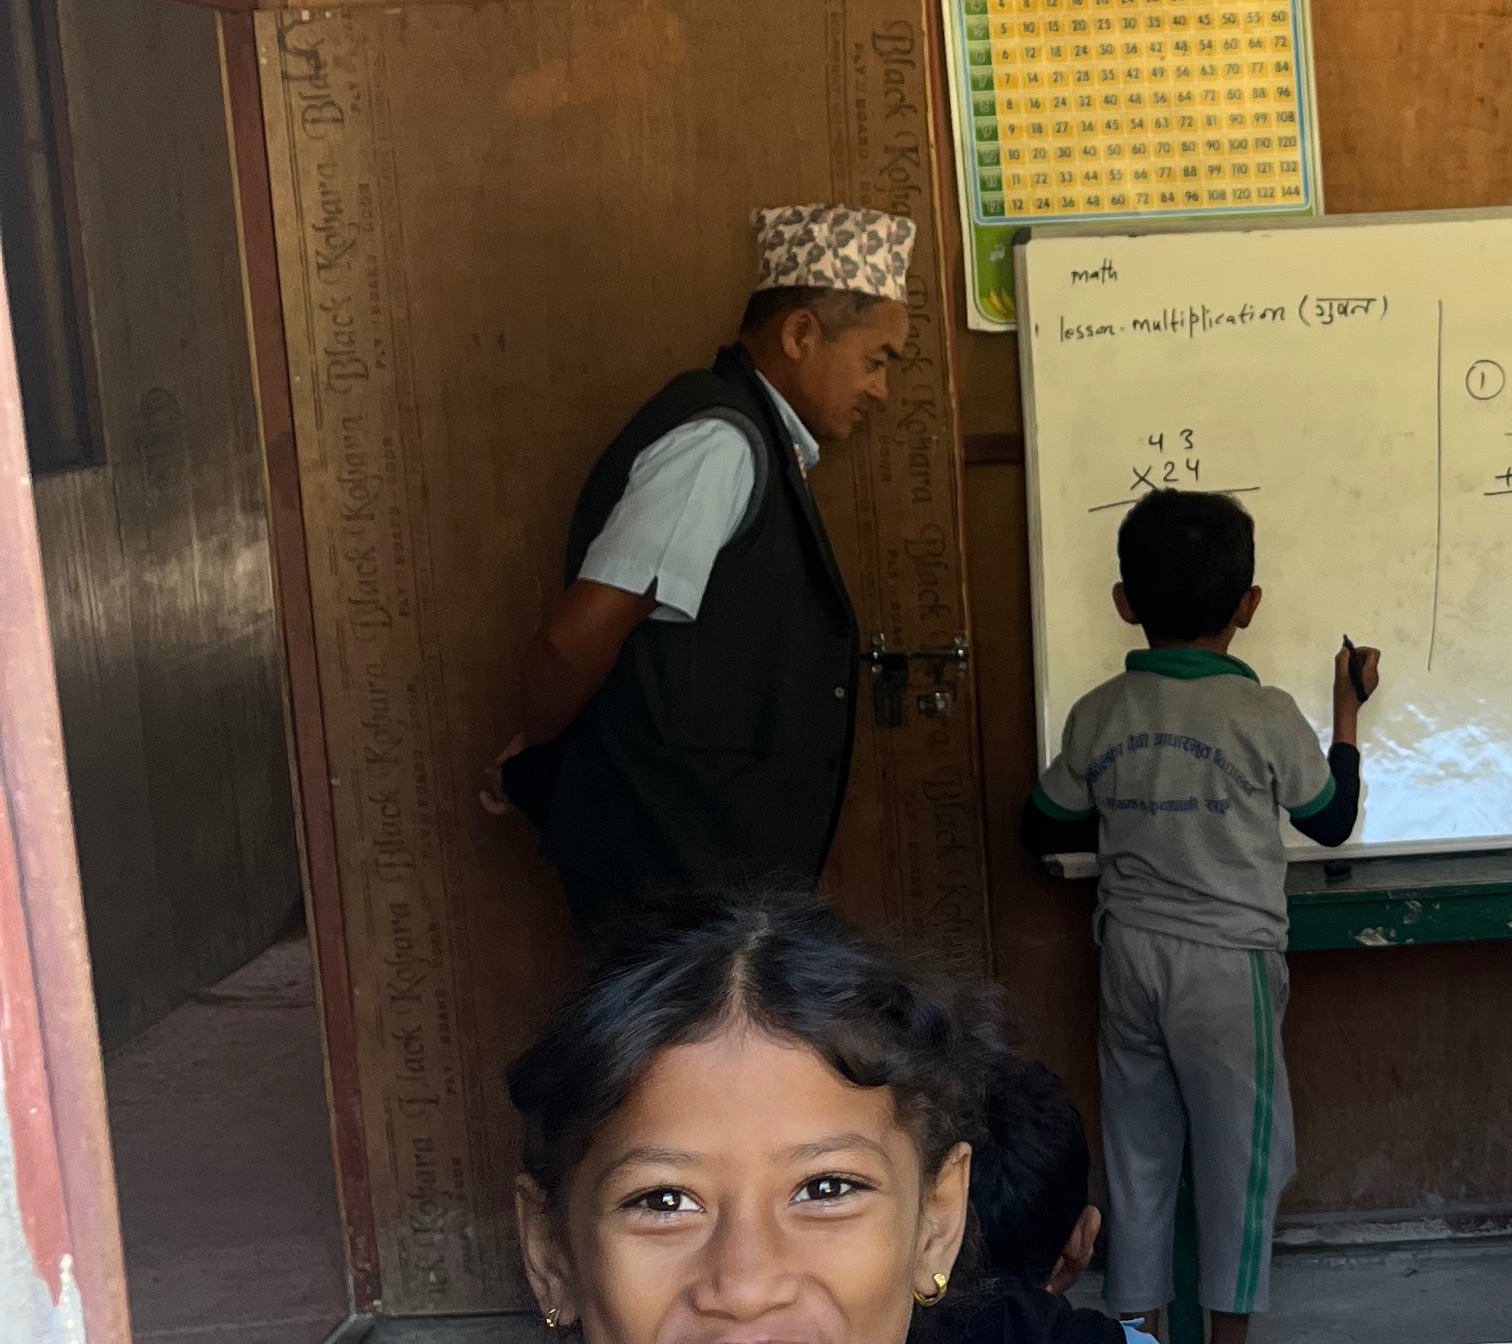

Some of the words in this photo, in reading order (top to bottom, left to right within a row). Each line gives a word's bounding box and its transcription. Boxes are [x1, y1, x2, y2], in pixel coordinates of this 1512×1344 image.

[1026, 72, 1039, 84] 14
[1051, 70, 1066, 84] 21
[1125, 67, 1140, 80] 42
[1150, 66, 1166, 79] 49
[1175, 65, 1191, 79] 56
[1199, 64, 1217, 77] 63
[1225, 63, 1241, 76] 70
[1250, 61, 1265, 75] 77
[1274, 61, 1290, 73] 84
[1053, 96, 1068, 109] 24
[1103, 94, 1118, 106] 40
[1127, 92, 1143, 105] 48
[1152, 91, 1169, 104] 56
[1176, 90, 1193, 103] 64
[1202, 89, 1217, 103] 72
[1226, 88, 1243, 101] 80
[1251, 86, 1269, 100] 88
[1276, 86, 1292, 98] 96
[1055, 121, 1069, 134] 27
[1104, 119, 1120, 131] 45
[1130, 117, 1145, 130] 54
[1154, 116, 1170, 129] 63
[1179, 115, 1194, 129] 72
[1205, 114, 1217, 127] 81
[1228, 113, 1246, 126] 90
[1252, 112, 1268, 125] 99
[1275, 110, 1297, 123] 108
[1031, 147, 1049, 161] 20
[1056, 146, 1073, 159] 30
[1081, 145, 1097, 157] 40
[1106, 143, 1123, 157] 50
[1131, 143, 1147, 156] 60
[1157, 141, 1172, 154] 70
[1180, 140, 1197, 153] 80
[1205, 139, 1221, 152] 90
[1228, 138, 1249, 153] 100
[1254, 136, 1273, 149] 110
[1278, 135, 1300, 149] 120
[1010, 173, 1022, 187] 11
[1034, 172, 1049, 185] 22
[1059, 171, 1074, 184] 33
[1083, 170, 1099, 182] 44
[1108, 168, 1123, 183] 55
[1133, 168, 1149, 181] 66
[1158, 166, 1173, 179] 77
[1182, 165, 1198, 178] 88
[1207, 164, 1222, 176] 99
[1231, 162, 1249, 176] 110
[1256, 161, 1274, 176] 121
[1279, 160, 1299, 173] 132
[1011, 198, 1024, 212] 12
[1036, 197, 1051, 210] 24
[1061, 196, 1076, 209] 36
[1085, 195, 1101, 208] 48
[1110, 193, 1126, 206] 60
[1136, 192, 1150, 205] 72
[1160, 191, 1176, 204] 84
[1184, 190, 1200, 202] 96
[1207, 189, 1227, 202] 108
[1232, 187, 1252, 201] 120
[1256, 186, 1276, 199] 132
[1281, 185, 1301, 198] 144
[1071, 258, 1118, 285] math
